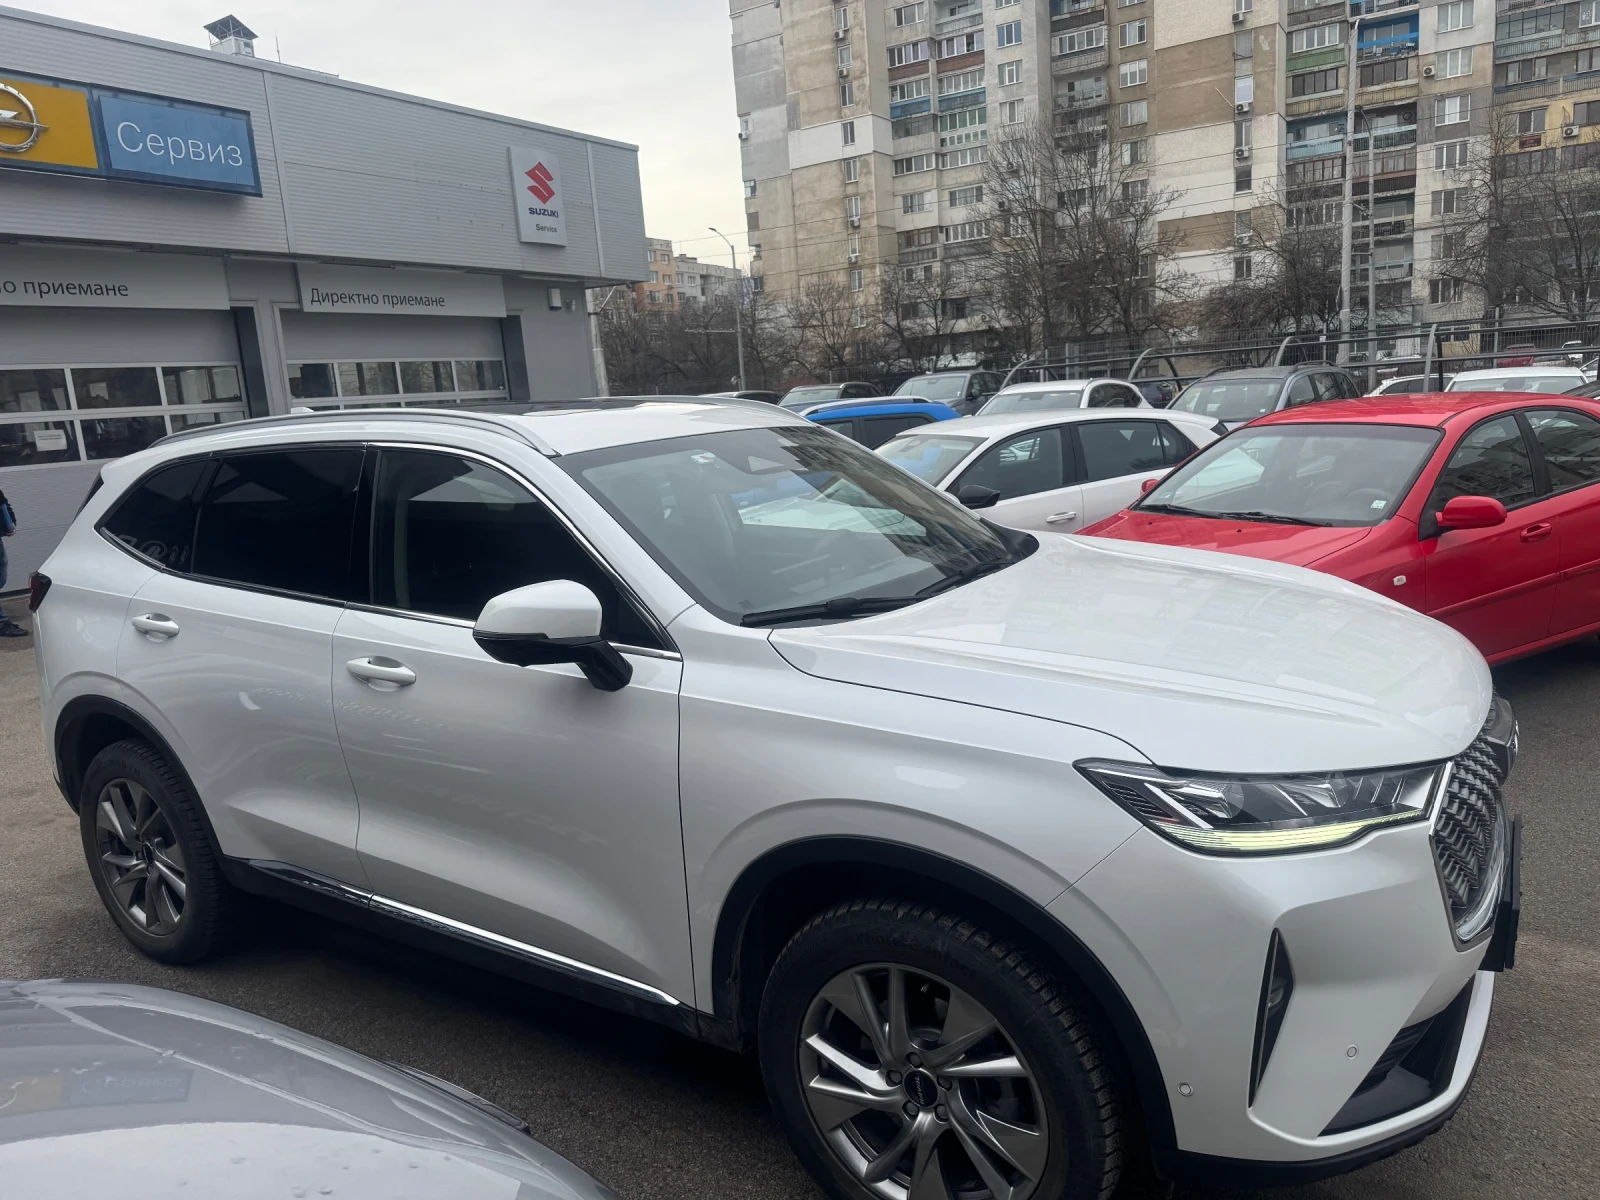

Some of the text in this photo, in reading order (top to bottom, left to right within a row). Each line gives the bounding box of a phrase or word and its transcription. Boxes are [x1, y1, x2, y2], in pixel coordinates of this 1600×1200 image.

[117, 121, 243, 167] Сервиз
[528, 207, 559, 218] SUZUKI
[535, 224, 557, 233] Service
[23, 281, 129, 299] приемане
[310, 287, 446, 309] Директно приемане
[914, 1075, 925, 1106] HAVAL
